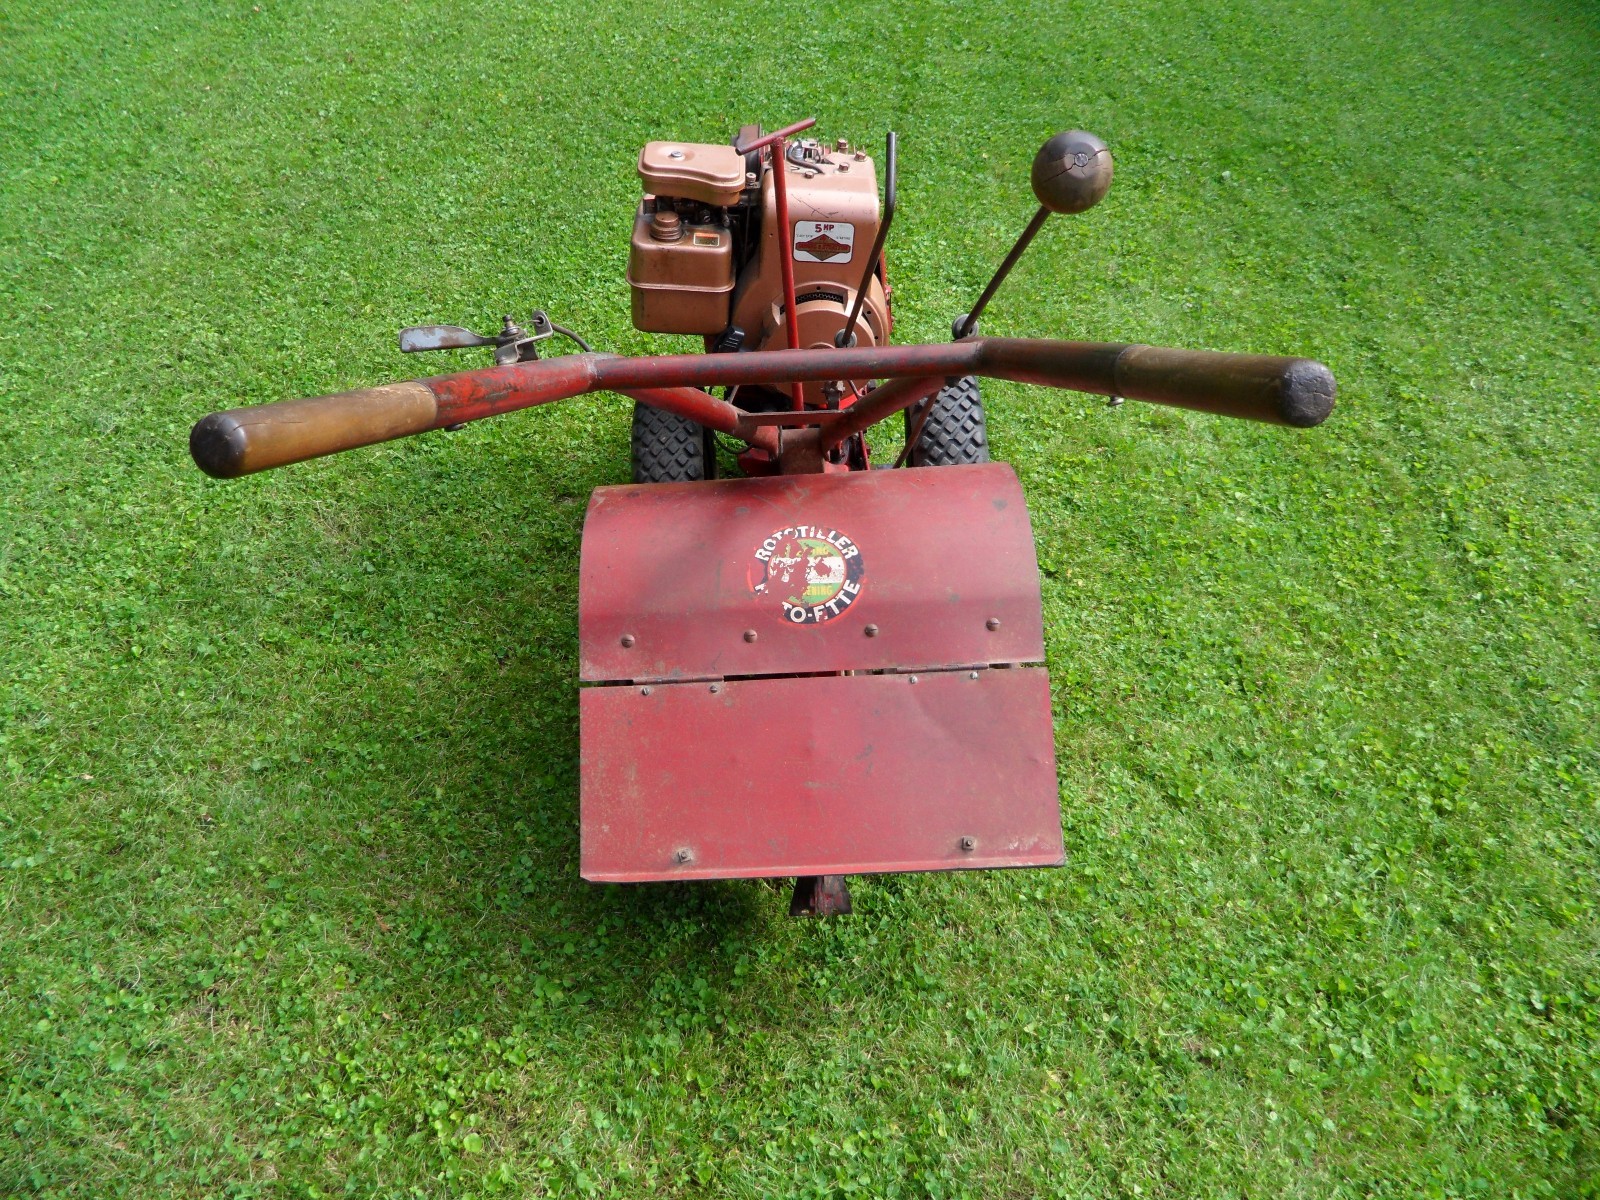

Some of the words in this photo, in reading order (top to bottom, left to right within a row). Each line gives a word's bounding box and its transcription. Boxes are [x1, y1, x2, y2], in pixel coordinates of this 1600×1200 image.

[814, 223, 822, 233] 5
[823, 223, 835, 231] HP
[754, 525, 859, 562] ROTOTILLER
